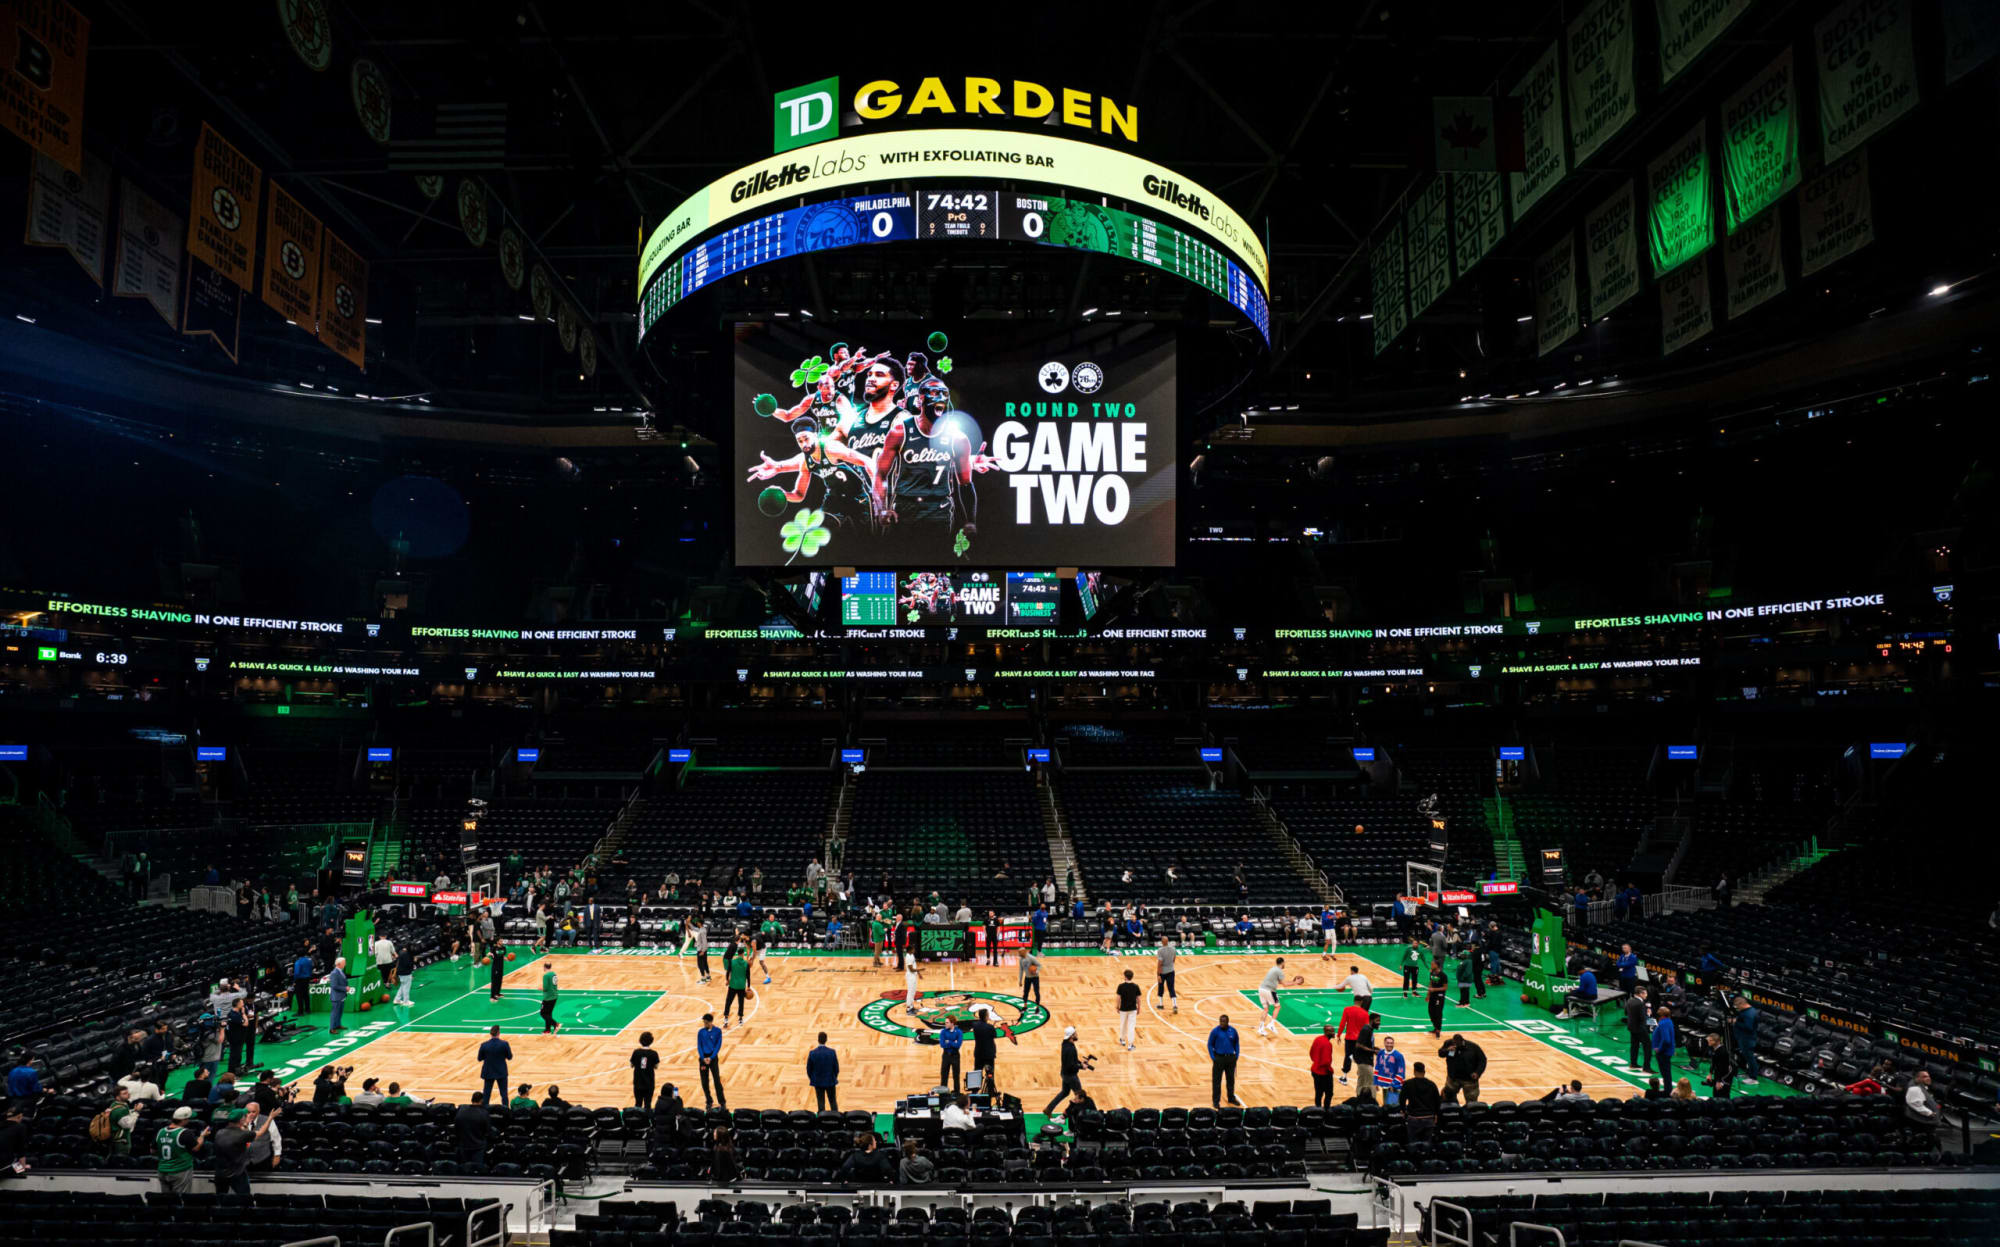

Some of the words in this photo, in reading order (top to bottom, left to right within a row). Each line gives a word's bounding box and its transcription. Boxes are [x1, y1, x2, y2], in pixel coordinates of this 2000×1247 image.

[1574, 10, 1626, 75] CELTICS
[1826, 8, 1898, 72] CELTICS
[1850, 61, 1882, 94] 1966
[1584, 81, 1619, 121] WORLD
[1842, 72, 1893, 118] WORLD
[780, 92, 833, 137] TD
[854, 76, 1138, 143] GARDEN
[1730, 90, 1789, 146] CELTICS
[1828, 83, 1911, 146] CHAMPIONS
[204, 129, 254, 185] BOSTON
[880, 151, 919, 164] WITH
[923, 151, 1021, 164] EXFOLIATING
[1026, 155, 1054, 168] BAR
[1523, 148, 1551, 182] WORLD
[1749, 140, 1774, 168] 1968
[203, 150, 252, 201] BRUINS
[1516, 153, 1560, 205] CHAMPIONS
[1656, 159, 1702, 204] CELTICS
[1744, 151, 1782, 186] WORLD
[219, 199, 235, 219] B
[854, 197, 911, 212] PHILADELPHIA
[928, 194, 987, 210] 74:42
[1016, 198, 1048, 211] BOSTON
[1670, 202, 1690, 222] 1969
[676, 217, 691, 235] BAR
[872, 212, 893, 238] 0
[947, 213, 967, 221] PrG
[1023, 212, 1044, 238] 0
[1457, 208, 1476, 240] 00
[809, 227, 855, 249] 76ers
[1488, 218, 1498, 245] 5
[1591, 215, 1629, 254] CELTICS
[1806, 218, 1870, 263] CHAMPIONS
[287, 252, 301, 268] B
[1458, 237, 1478, 272] 34
[1005, 402, 1079, 418] ROUND
[1092, 403, 1136, 418] TWO
[903, 449, 951, 463] Celtics
[992, 420, 1147, 473] GAME
[932, 465, 946, 485] 7
[1009, 473, 1130, 526] TWO
[960, 587, 1000, 602] GAME
[1022, 585, 1047, 593] 74:42
[48, 600, 127, 617] EFFORTLESS
[131, 608, 191, 623] SHAVING
[194, 613, 210, 625] IN
[212, 615, 240, 627] ONE
[243, 617, 298, 630] EFFICIENT
[300, 621, 342, 633] STROKE
[964, 601, 996, 615] TWO
[1574, 616, 1641, 630] EFFORTLESS
[1644, 611, 1703, 625] SHAVING
[1706, 609, 1722, 621] IN
[1724, 606, 1754, 619] ONE
[1757, 599, 1822, 616] EFFICIENT
[1825, 593, 1883, 610] STROKE
[411, 626, 469, 638] EFFORTLESS
[471, 628, 519, 639] SHAVING
[521, 630, 532, 640] IN
[534, 630, 554, 640] ONE
[556, 629, 600, 640] EFFICIENT
[601, 629, 636, 640] STROKE
[705, 630, 757, 639] EFFORTLESS
[844, 629, 887, 639] FFICIENT
[889, 629, 925, 638] STROKE
[1103, 629, 1124, 638] ONE
[1126, 629, 1169, 638] EFFICIENT
[1171, 629, 1207, 638] STROKE
[1274, 629, 1327, 639] EFFORTLESS
[1328, 629, 1372, 639] SHAVING
[1374, 628, 1387, 638] IN
[1389, 627, 1411, 638] ONE
[1414, 625, 1461, 637] EFFICIENT
[1463, 624, 1503, 635] STROKE
[59, 651, 82, 660] Bank
[96, 652, 128, 665] 6:39
[1613, 660, 1653, 668] WASHING
[921, 930, 963, 938] CELTICS
[864, 999, 900, 1032] BOSTON
[1753, 994, 1795, 1012] GARDEN
[1820, 1013, 1869, 1034] GARDEN
[268, 1021, 397, 1079] GARDEN
[1901, 1037, 1959, 1062] GARDEN
[162, 1145, 171, 1160] 0
